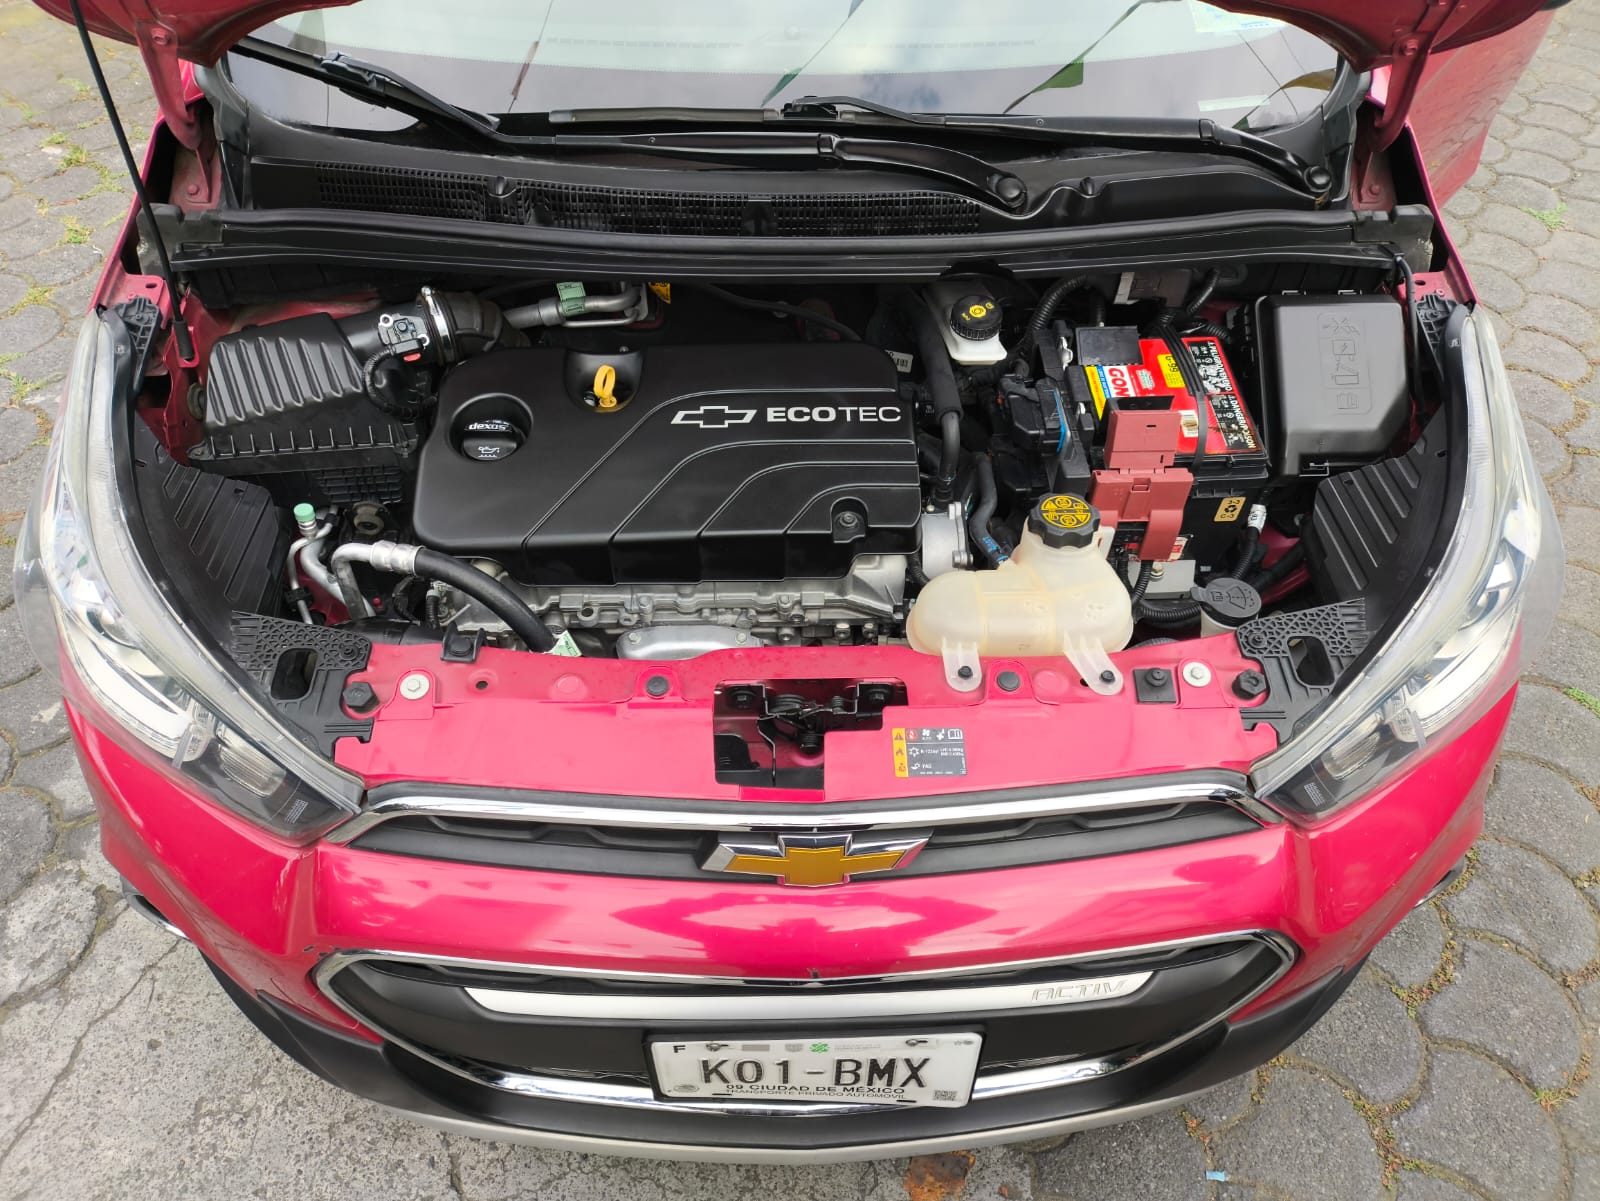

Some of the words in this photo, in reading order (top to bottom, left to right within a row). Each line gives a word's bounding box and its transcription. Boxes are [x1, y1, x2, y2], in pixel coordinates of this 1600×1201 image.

[766, 406, 902, 423] ECOTEC
[468, 422, 506, 431] dexos
[1031, 979, 1128, 1001] ACTIV
[672, 1045, 686, 1053] F
[702, 1058, 930, 1088] K01-BMX
[749, 1084, 810, 1092] CIUDAD
[843, 1085, 905, 1095] MÉXICO
